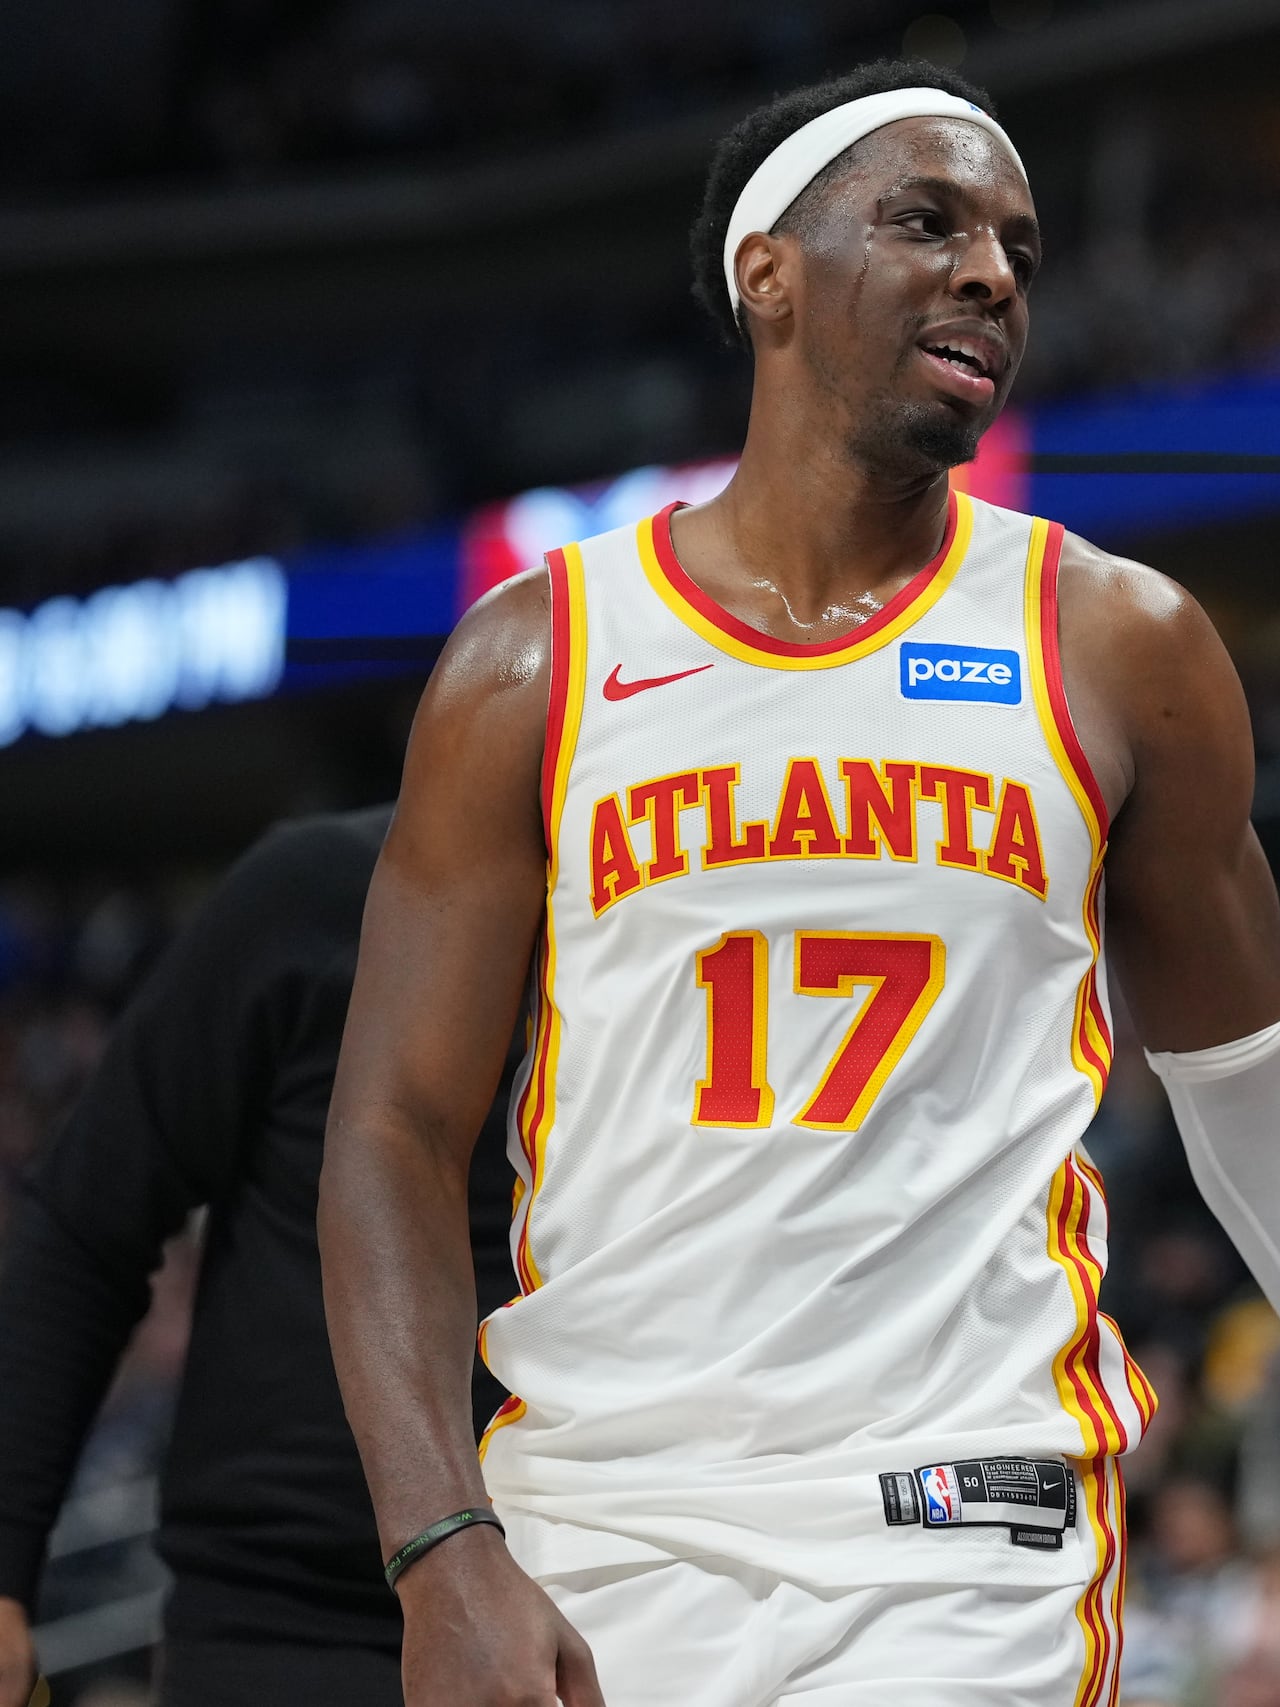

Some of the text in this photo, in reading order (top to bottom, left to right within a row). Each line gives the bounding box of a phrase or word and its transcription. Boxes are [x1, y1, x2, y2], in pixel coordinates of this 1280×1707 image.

[908, 656, 1013, 688] paze
[589, 757, 1048, 919] ATLANTA
[690, 929, 946, 1131] 17
[985, 1464, 1034, 1473] ENGINEERED
[963, 1477, 979, 1488] 50
[454, 1512, 473, 1521] We
[931, 1508, 944, 1520] NBA
[402, 1534, 429, 1558] Never
